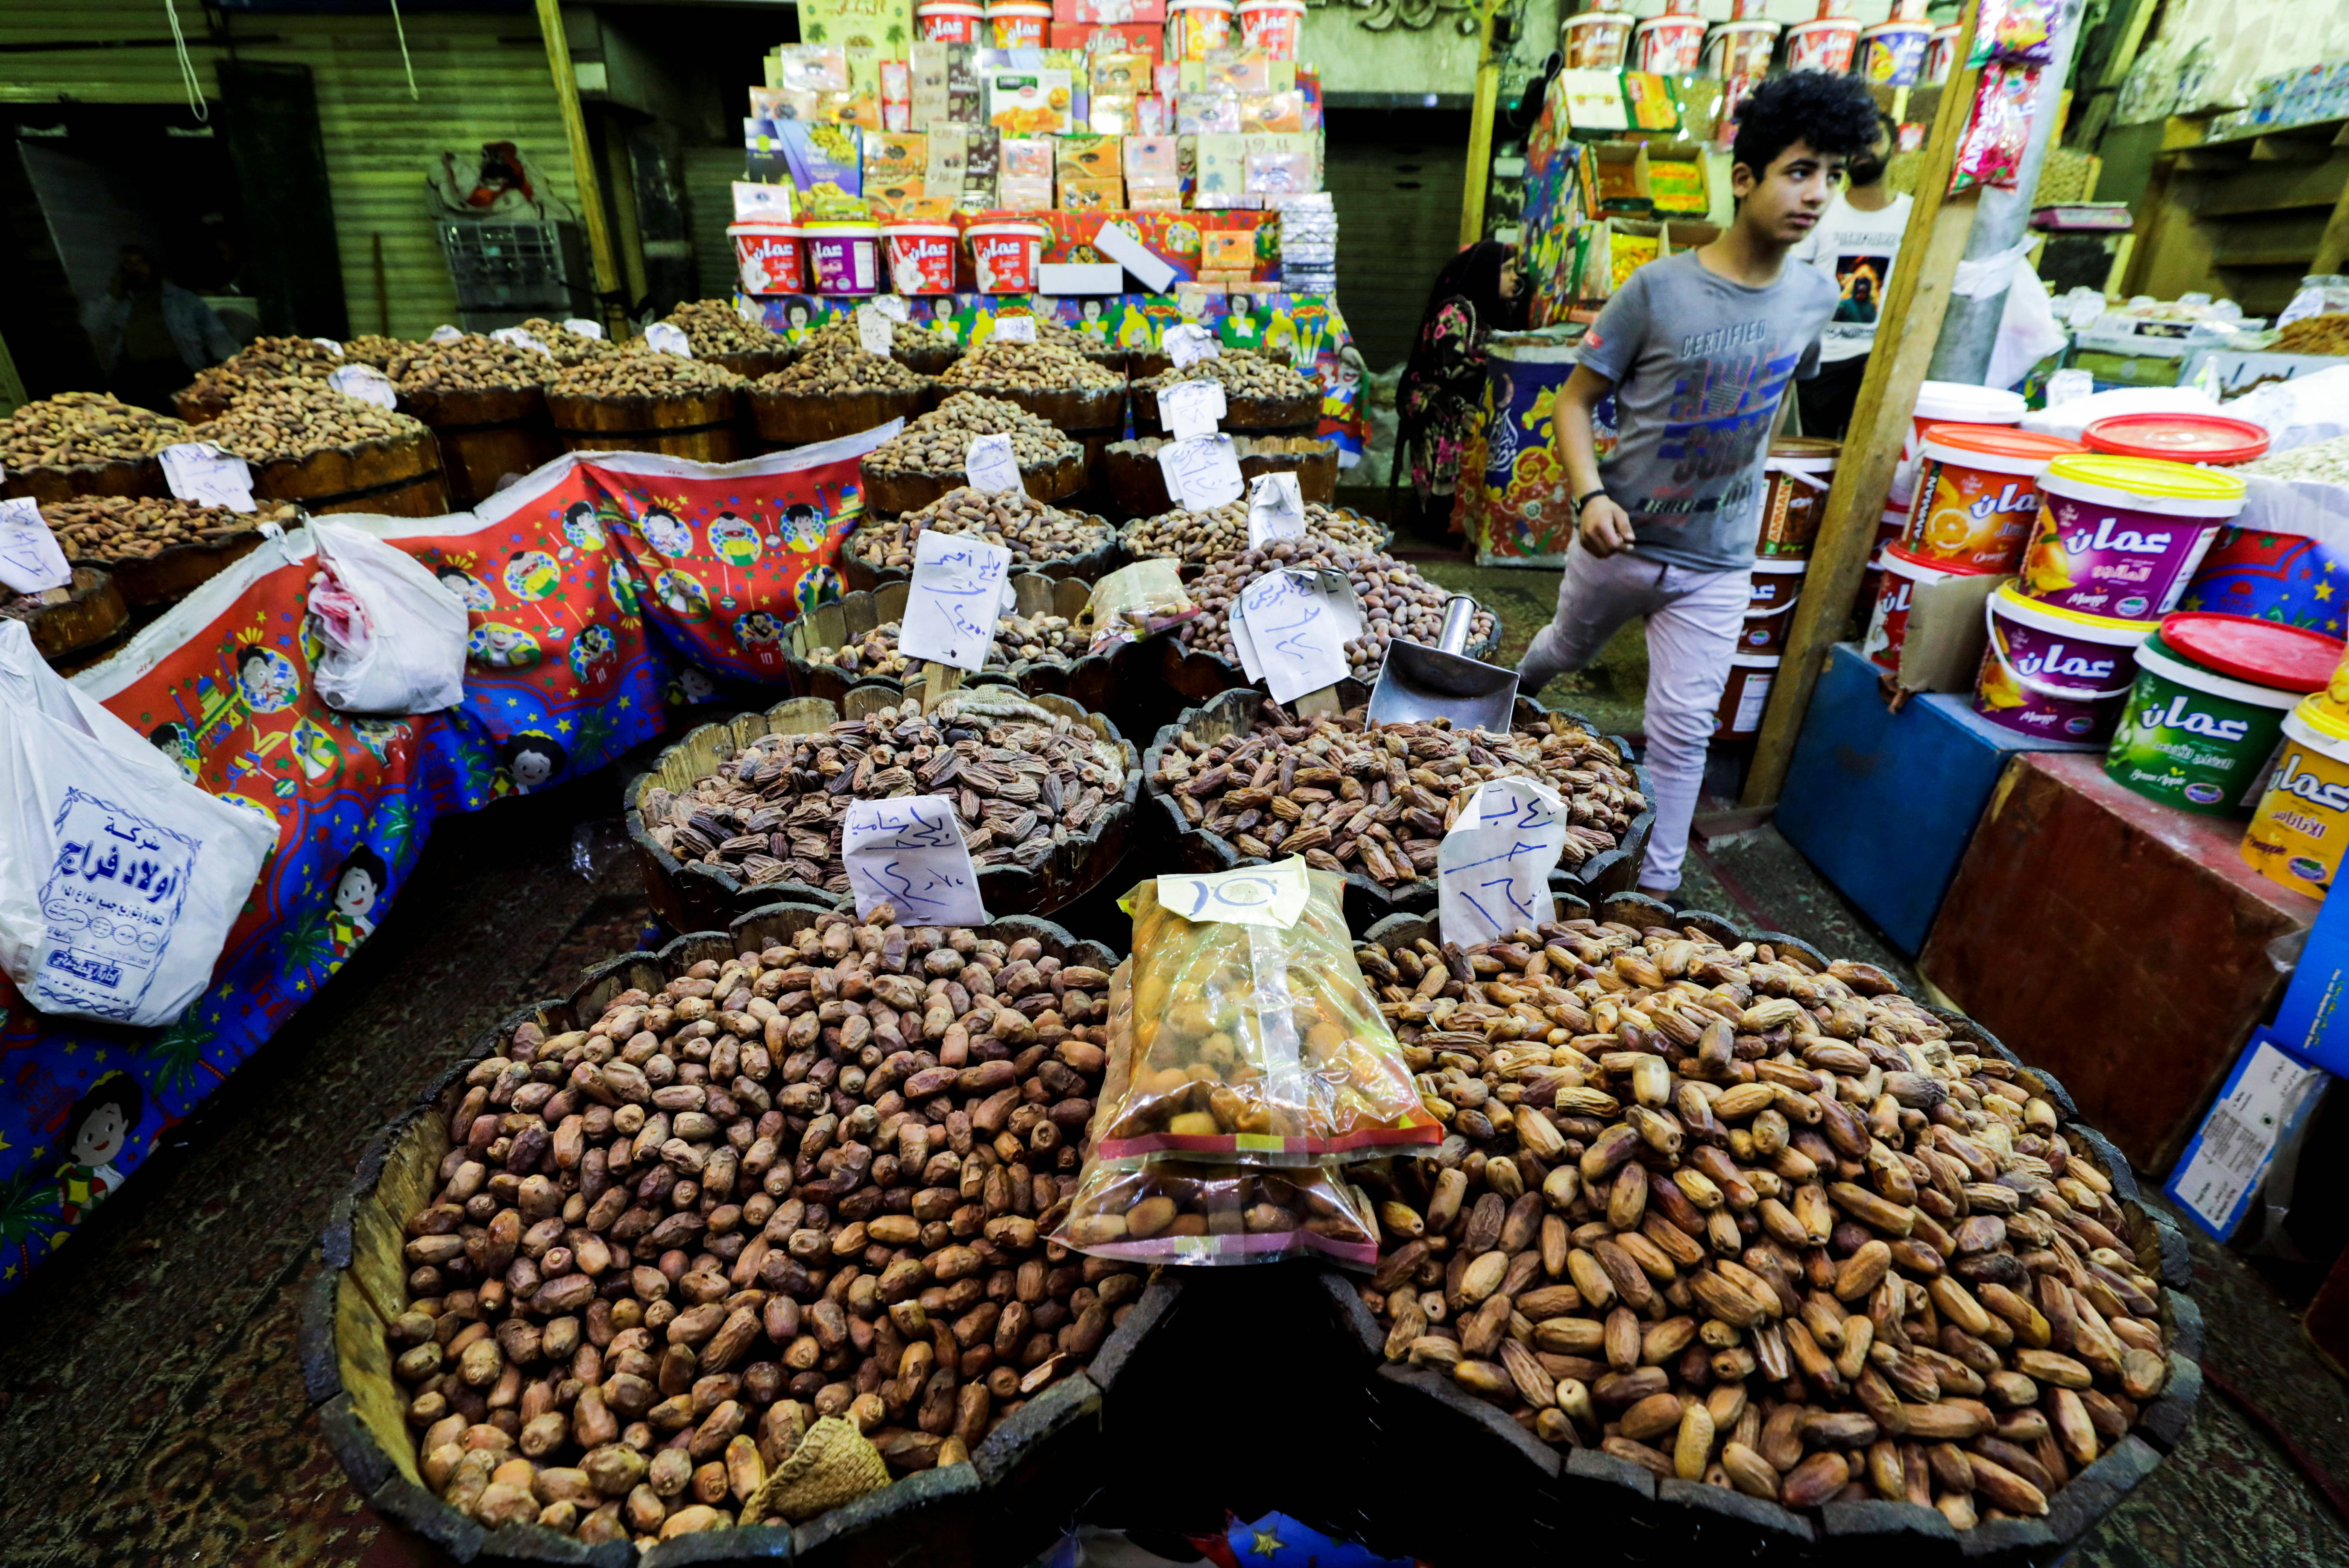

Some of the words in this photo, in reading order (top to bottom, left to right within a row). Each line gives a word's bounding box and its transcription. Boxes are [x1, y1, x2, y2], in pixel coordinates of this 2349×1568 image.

[753, 238, 794, 262] عمان
[908, 238, 947, 262] عمان
[981, 237, 1020, 262] عمان
[1682, 319, 1766, 360] CERTIFIED
[1769, 485, 1790, 541] AMMAN
[1913, 476, 1938, 539] AMMAN
[1969, 483, 2039, 519] مان
[2065, 517, 2172, 555] عمان
[1972, 551, 2008, 563] Orange
[2066, 592, 2109, 608] Mango
[2017, 644, 2115, 678] عمان
[2019, 711, 2058, 725] Mango
[2141, 695, 2248, 741] عمان
[104, 815, 161, 851] شركة
[59, 840, 120, 883] فراج
[120, 858, 182, 905] أولاد
